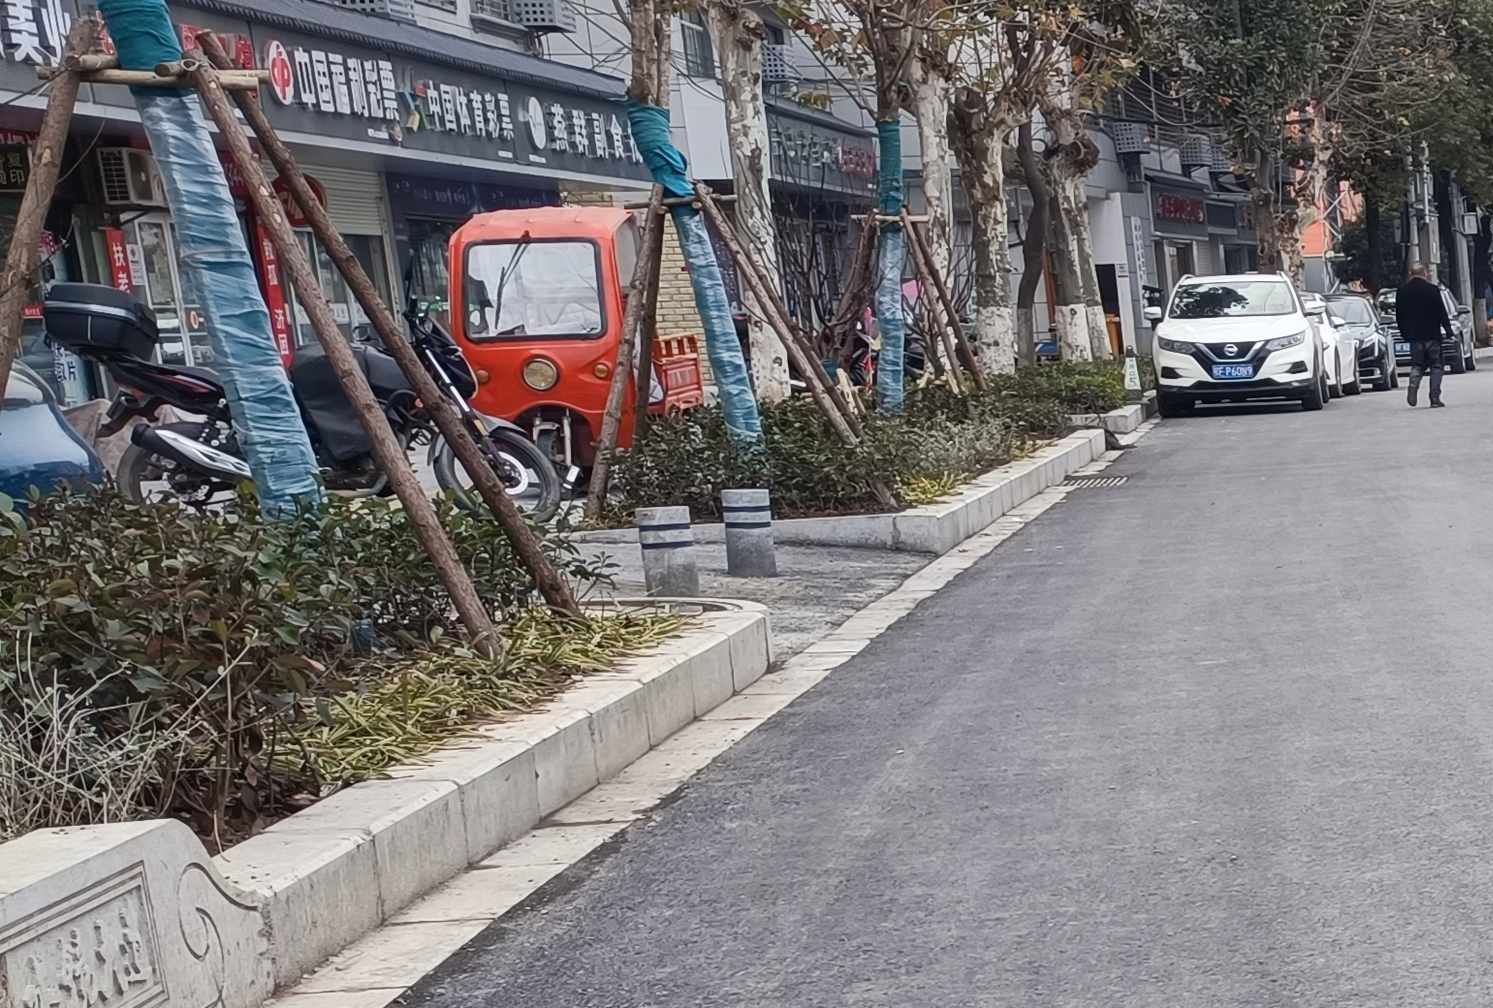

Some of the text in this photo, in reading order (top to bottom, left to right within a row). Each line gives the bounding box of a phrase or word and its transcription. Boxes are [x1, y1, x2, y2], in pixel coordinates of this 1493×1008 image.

[294, 47, 400, 122] 中国福利彩票
[427, 80, 514, 140] 中国体育彩票
